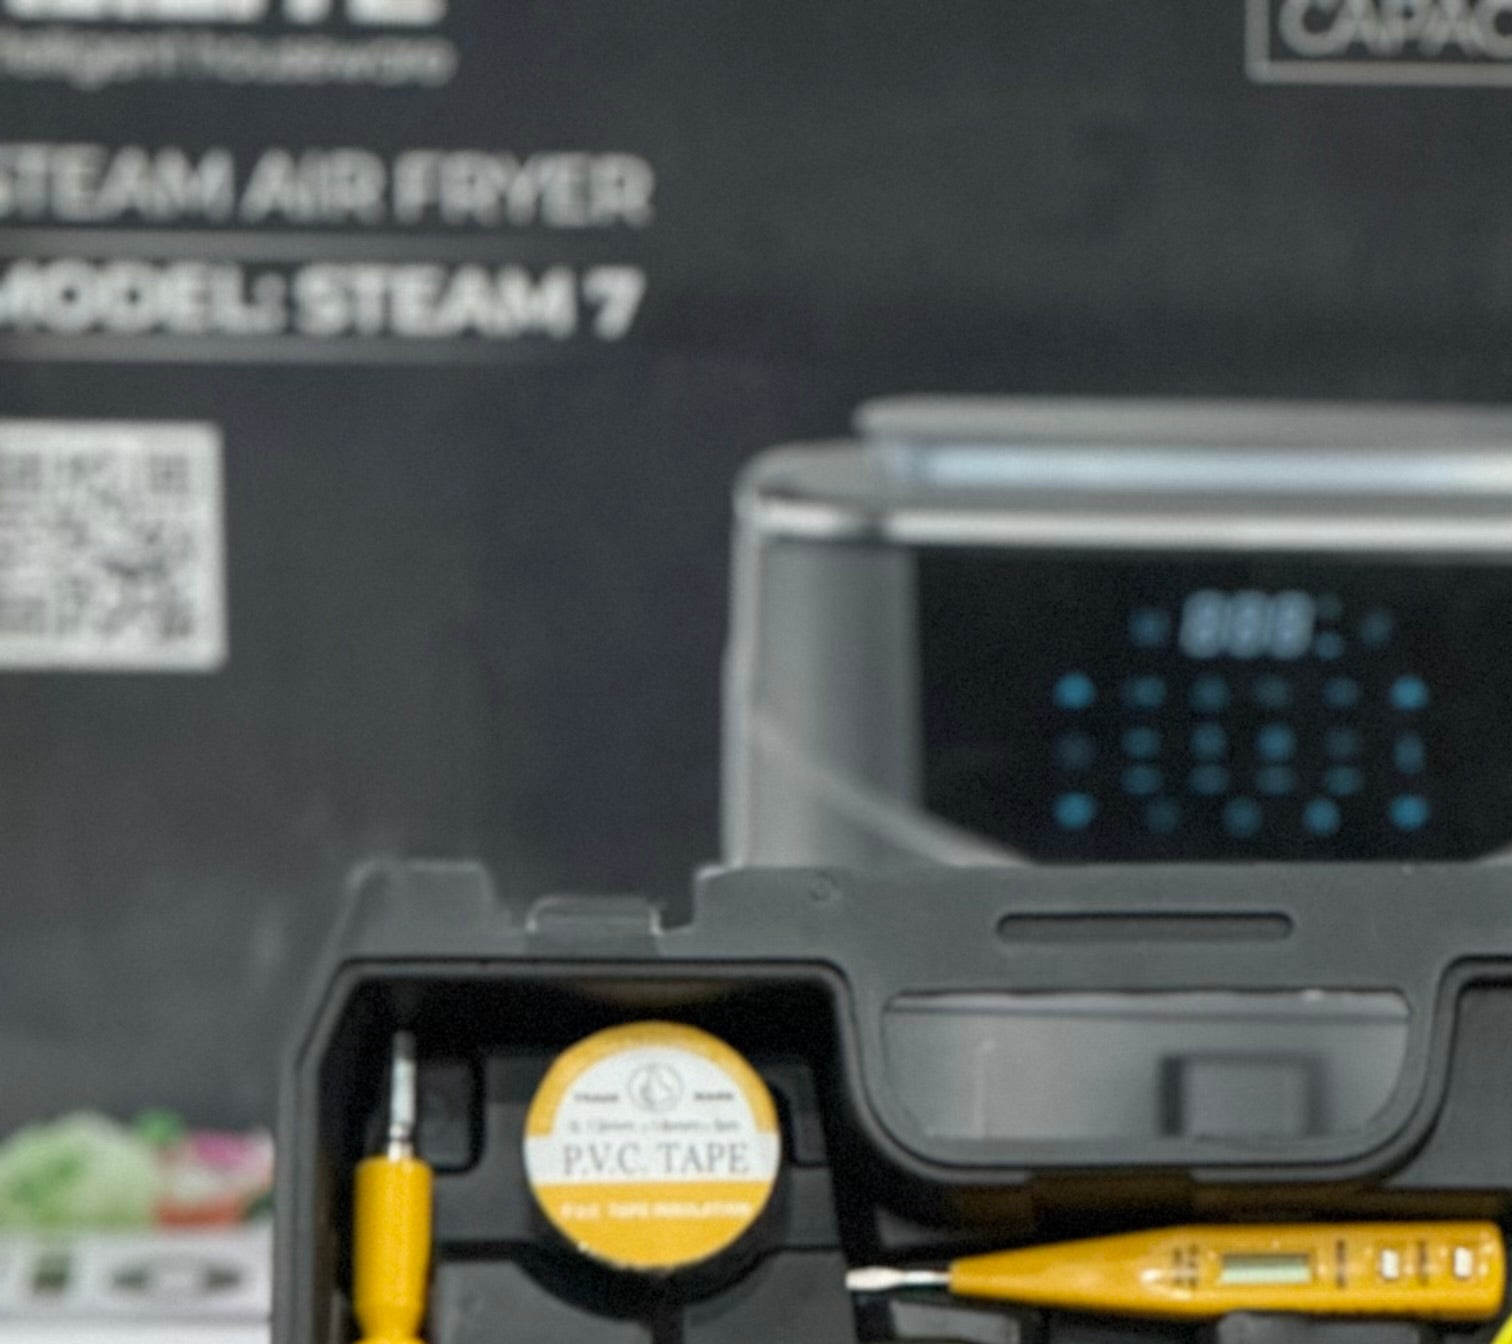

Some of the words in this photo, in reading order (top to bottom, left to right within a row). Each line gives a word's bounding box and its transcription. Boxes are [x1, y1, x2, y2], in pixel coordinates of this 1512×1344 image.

[239, 146, 386, 226] AIR
[393, 148, 656, 230] FRYER
[293, 260, 579, 342] STEAM
[582, 264, 648, 343] 7
[655, 1142, 751, 1175] TAPE
